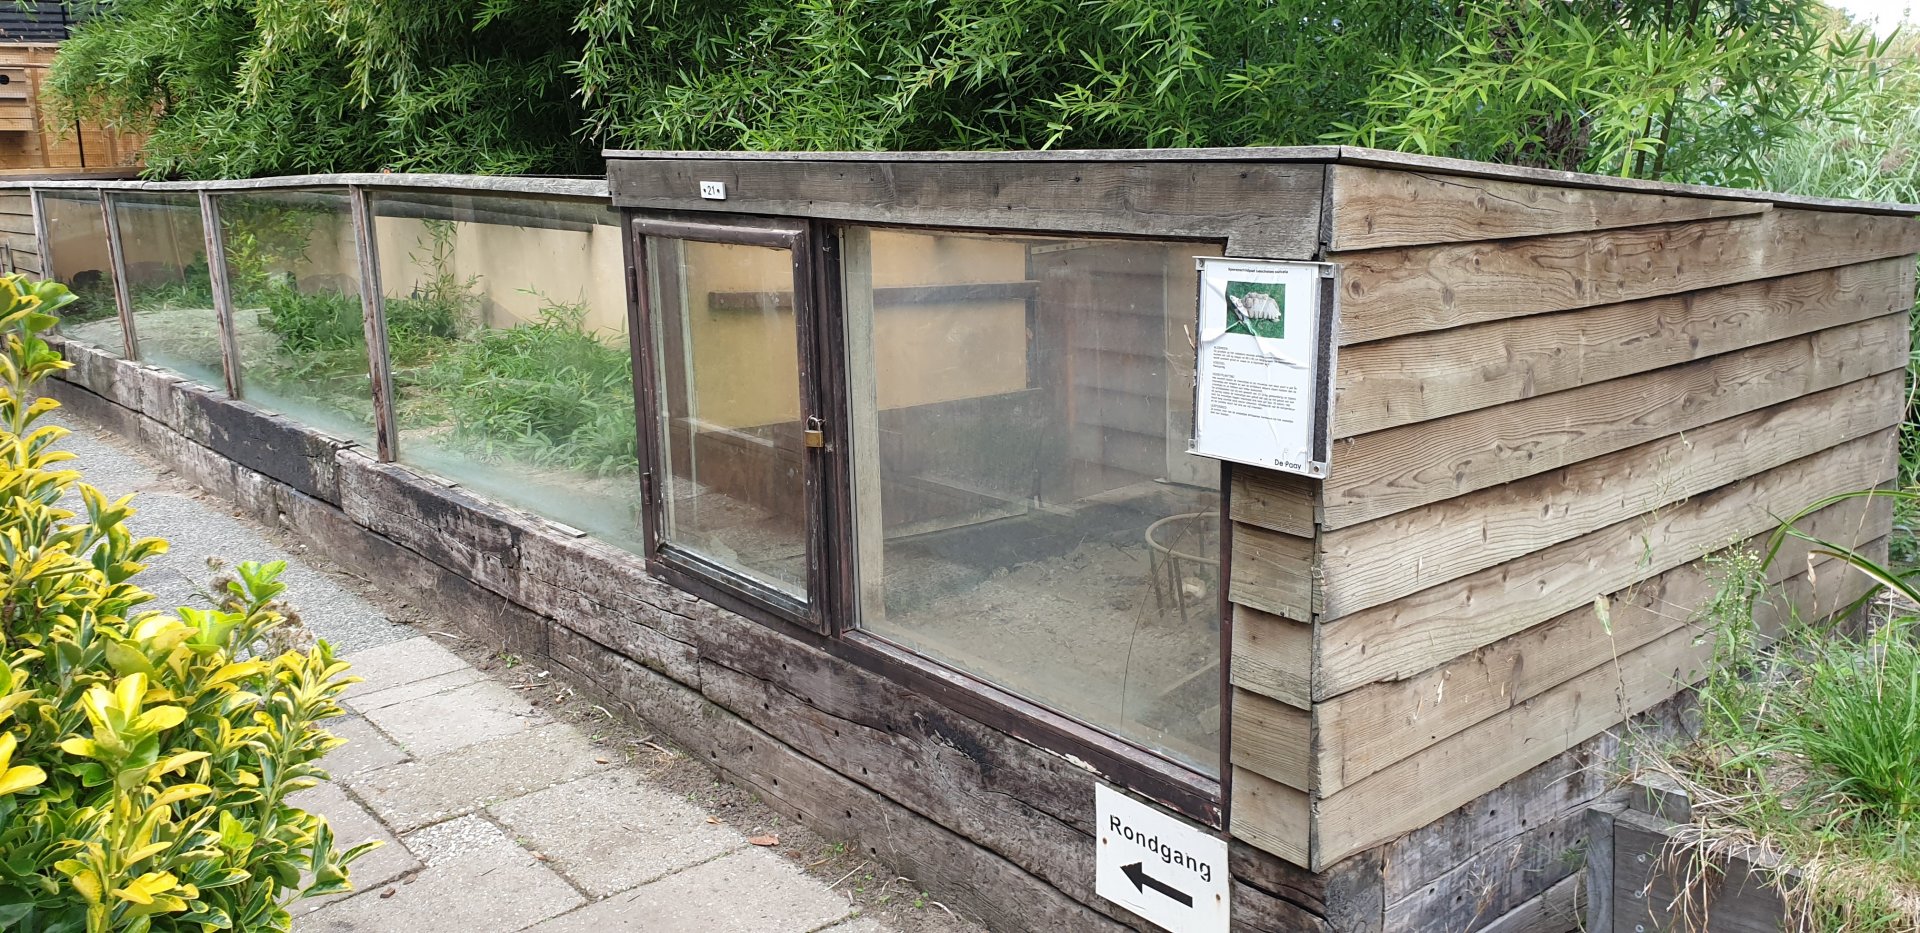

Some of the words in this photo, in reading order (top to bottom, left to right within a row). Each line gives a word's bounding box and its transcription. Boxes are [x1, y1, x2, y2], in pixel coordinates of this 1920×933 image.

[707, 185, 716, 196] 21
[1274, 459, 1284, 467] De
[1285, 460, 1302, 470] Paay
[1109, 814, 1211, 883] Rondgang
